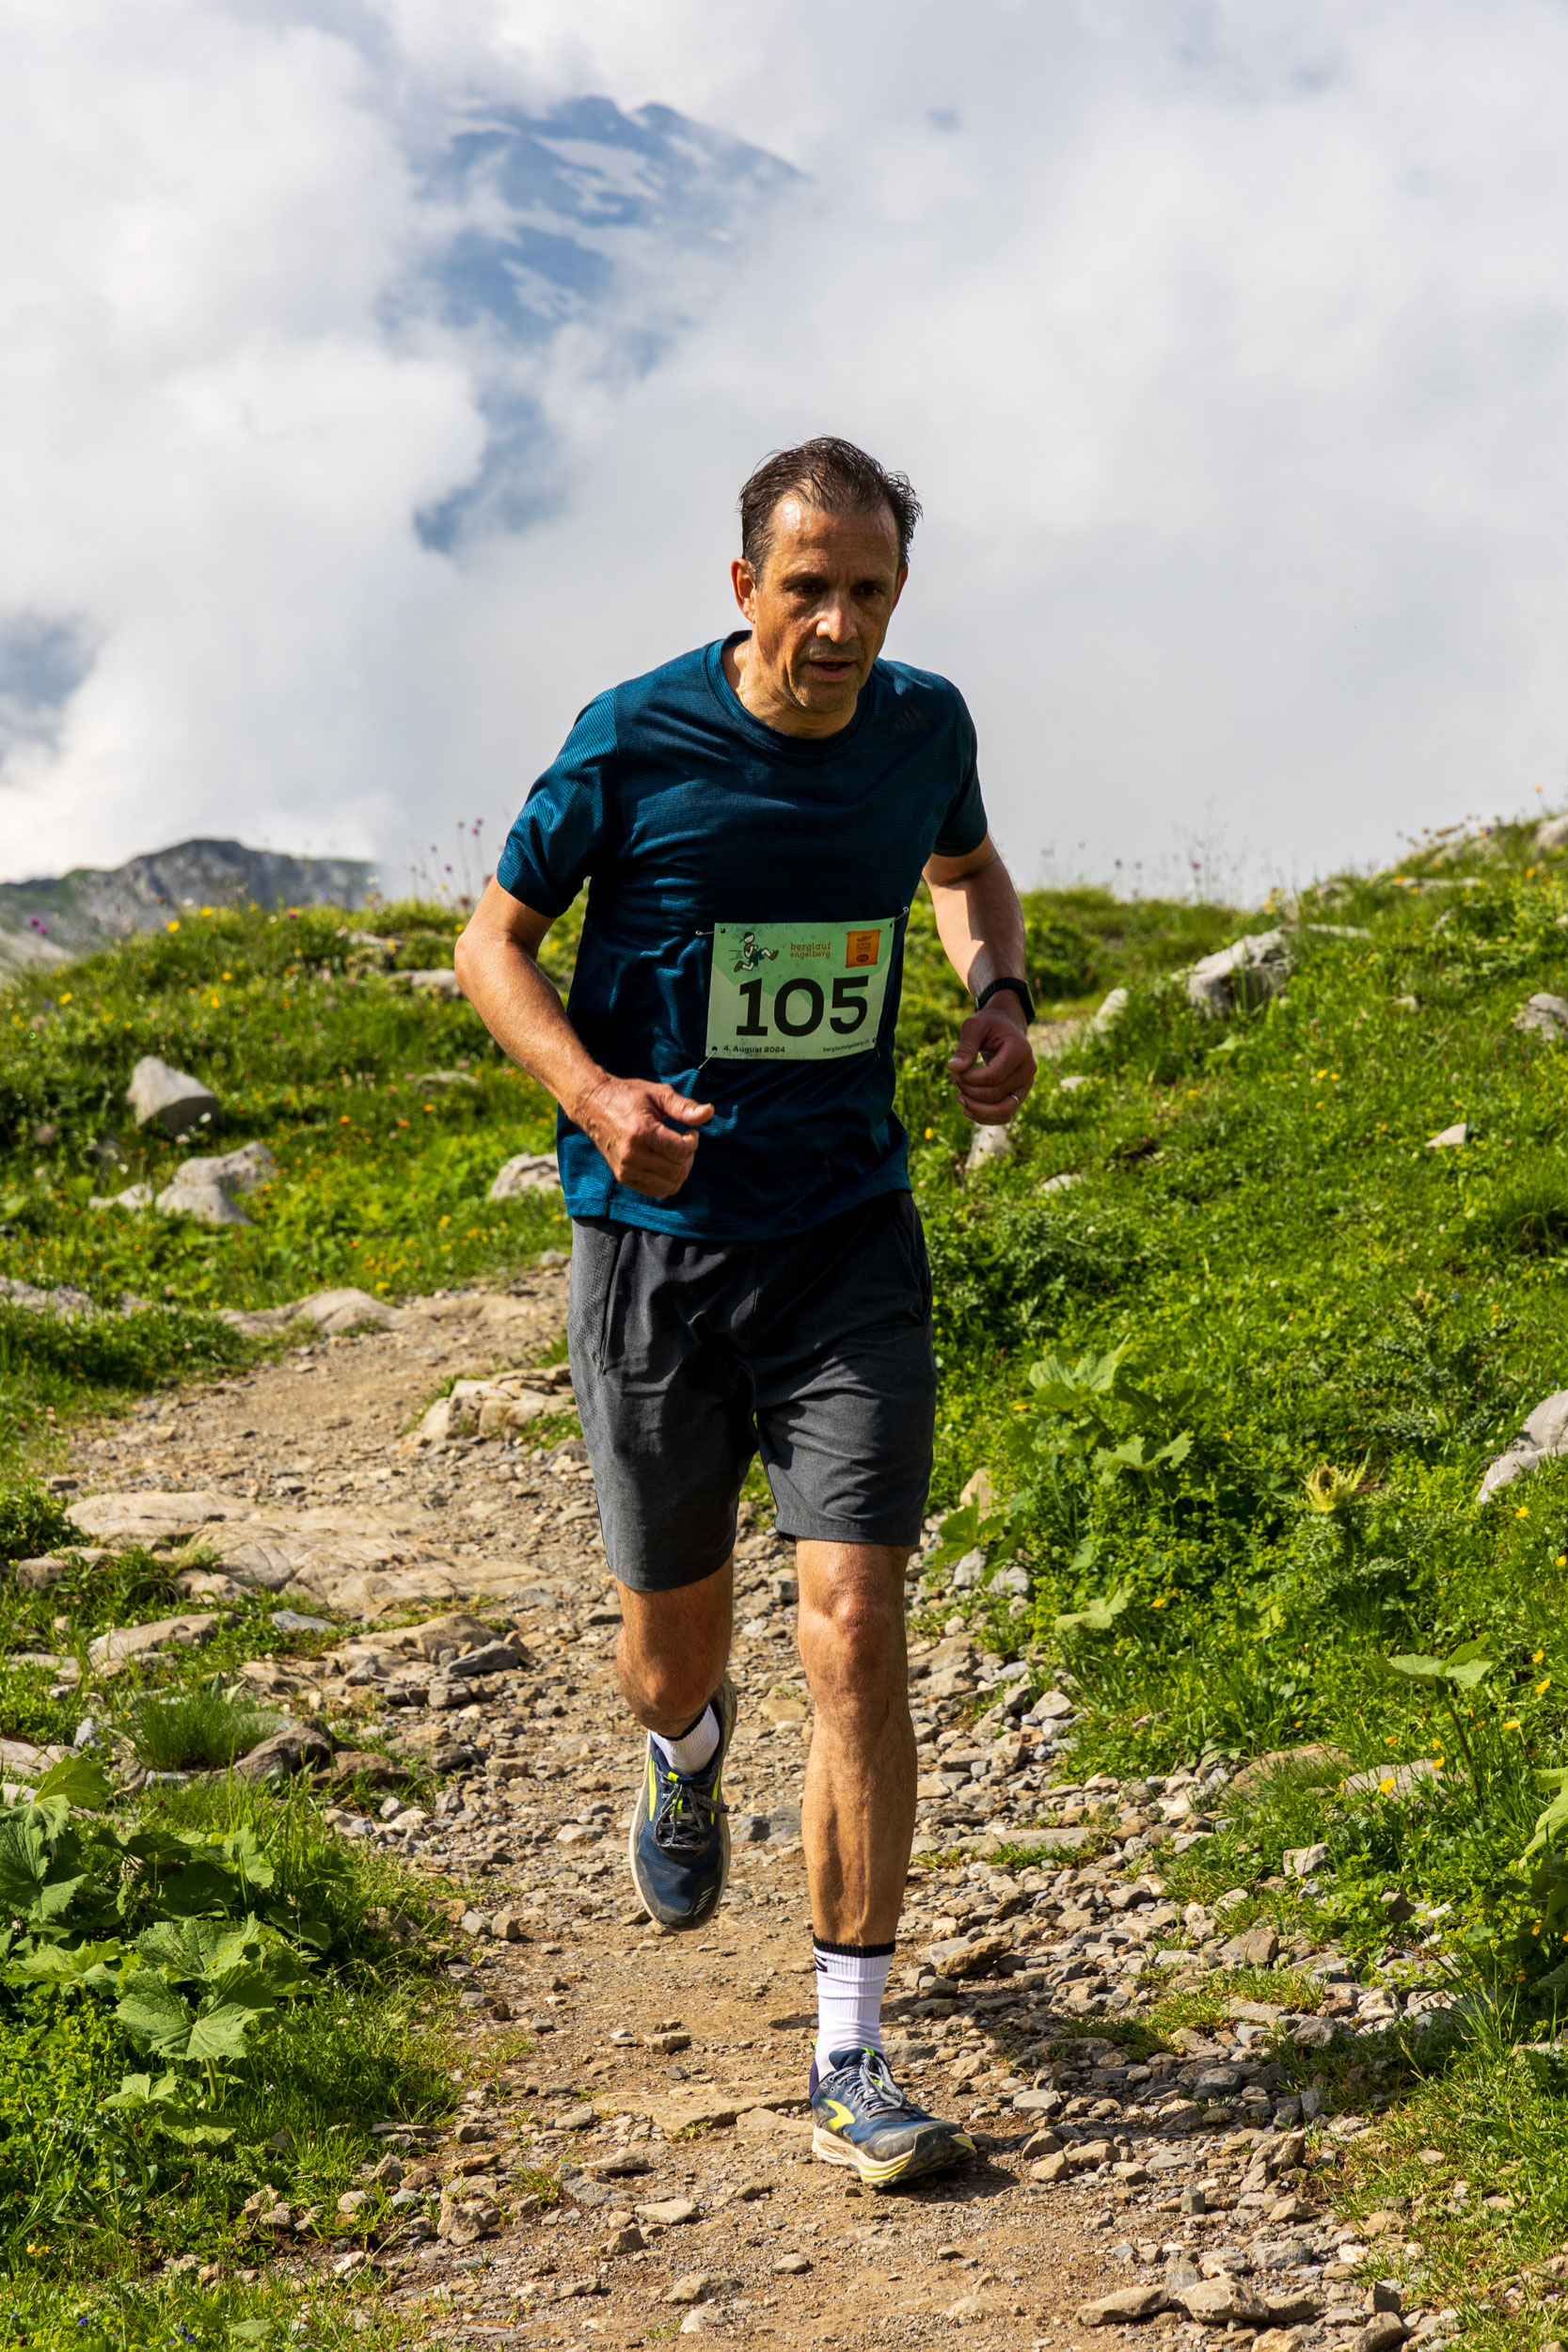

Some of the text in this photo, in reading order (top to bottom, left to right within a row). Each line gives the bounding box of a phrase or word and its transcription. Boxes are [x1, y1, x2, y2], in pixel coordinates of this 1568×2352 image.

[790, 942, 832, 951] berglauf
[790, 950, 832, 960] engelberg
[736, 975, 869, 1037] 105
[733, 1045, 763, 1054] August
